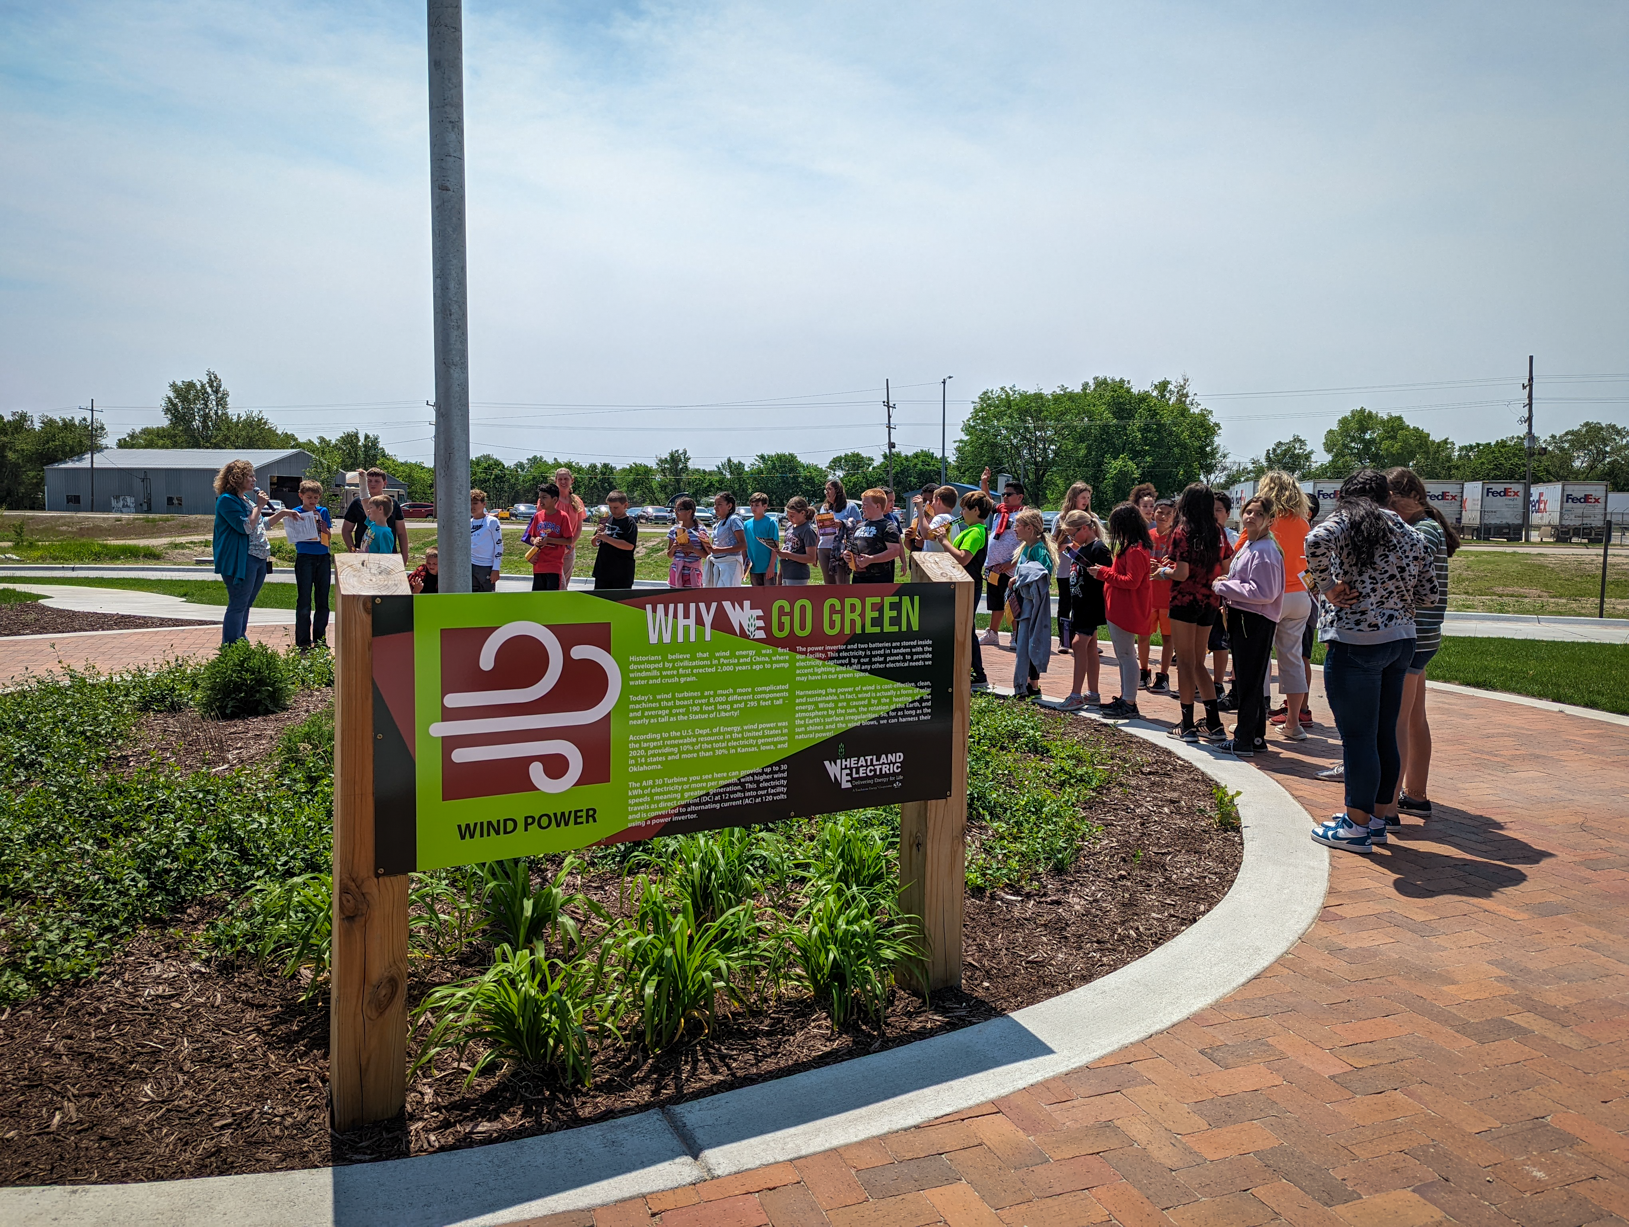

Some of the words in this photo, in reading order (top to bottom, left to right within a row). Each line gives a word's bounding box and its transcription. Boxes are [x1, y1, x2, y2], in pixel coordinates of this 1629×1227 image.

[1318, 490, 1340, 499] FedE
[1486, 488, 1520, 498] FedEx
[1566, 494, 1602, 504] FedEx
[646, 602, 718, 644] WHY
[771, 598, 812, 638] GO
[822, 596, 920, 636] GREEN
[629, 662, 662, 671] developed
[796, 659, 822, 667] electricity
[825, 658, 848, 666] captured
[629, 694, 652, 702] Today's
[755, 684, 788, 693] complicated
[709, 696, 726, 704] 8,000
[754, 691, 788, 701] components
[795, 688, 825, 697] Harnessing
[629, 718, 648, 726] nearly
[716, 711, 739, 720] Liberty!
[629, 732, 660, 742] According
[815, 731, 833, 739] power!
[641, 740, 662, 748] largest
[664, 736, 696, 745] renewable
[647, 746, 678, 756] providing
[728, 738, 756, 748] electricity
[757, 735, 787, 745] generation
[824, 752, 904, 783] WHEATLAND
[841, 763, 902, 788] ELECTRIC
[651, 784, 682, 794] electricity
[754, 774, 772, 782] higher
[628, 795, 650, 805] speeds
[653, 792, 680, 802] meaning
[683, 789, 705, 798] greater
[759, 779, 787, 789] electricity
[456, 818, 518, 840] WIND
[524, 808, 598, 832] POWER
[628, 819, 645, 828] using
